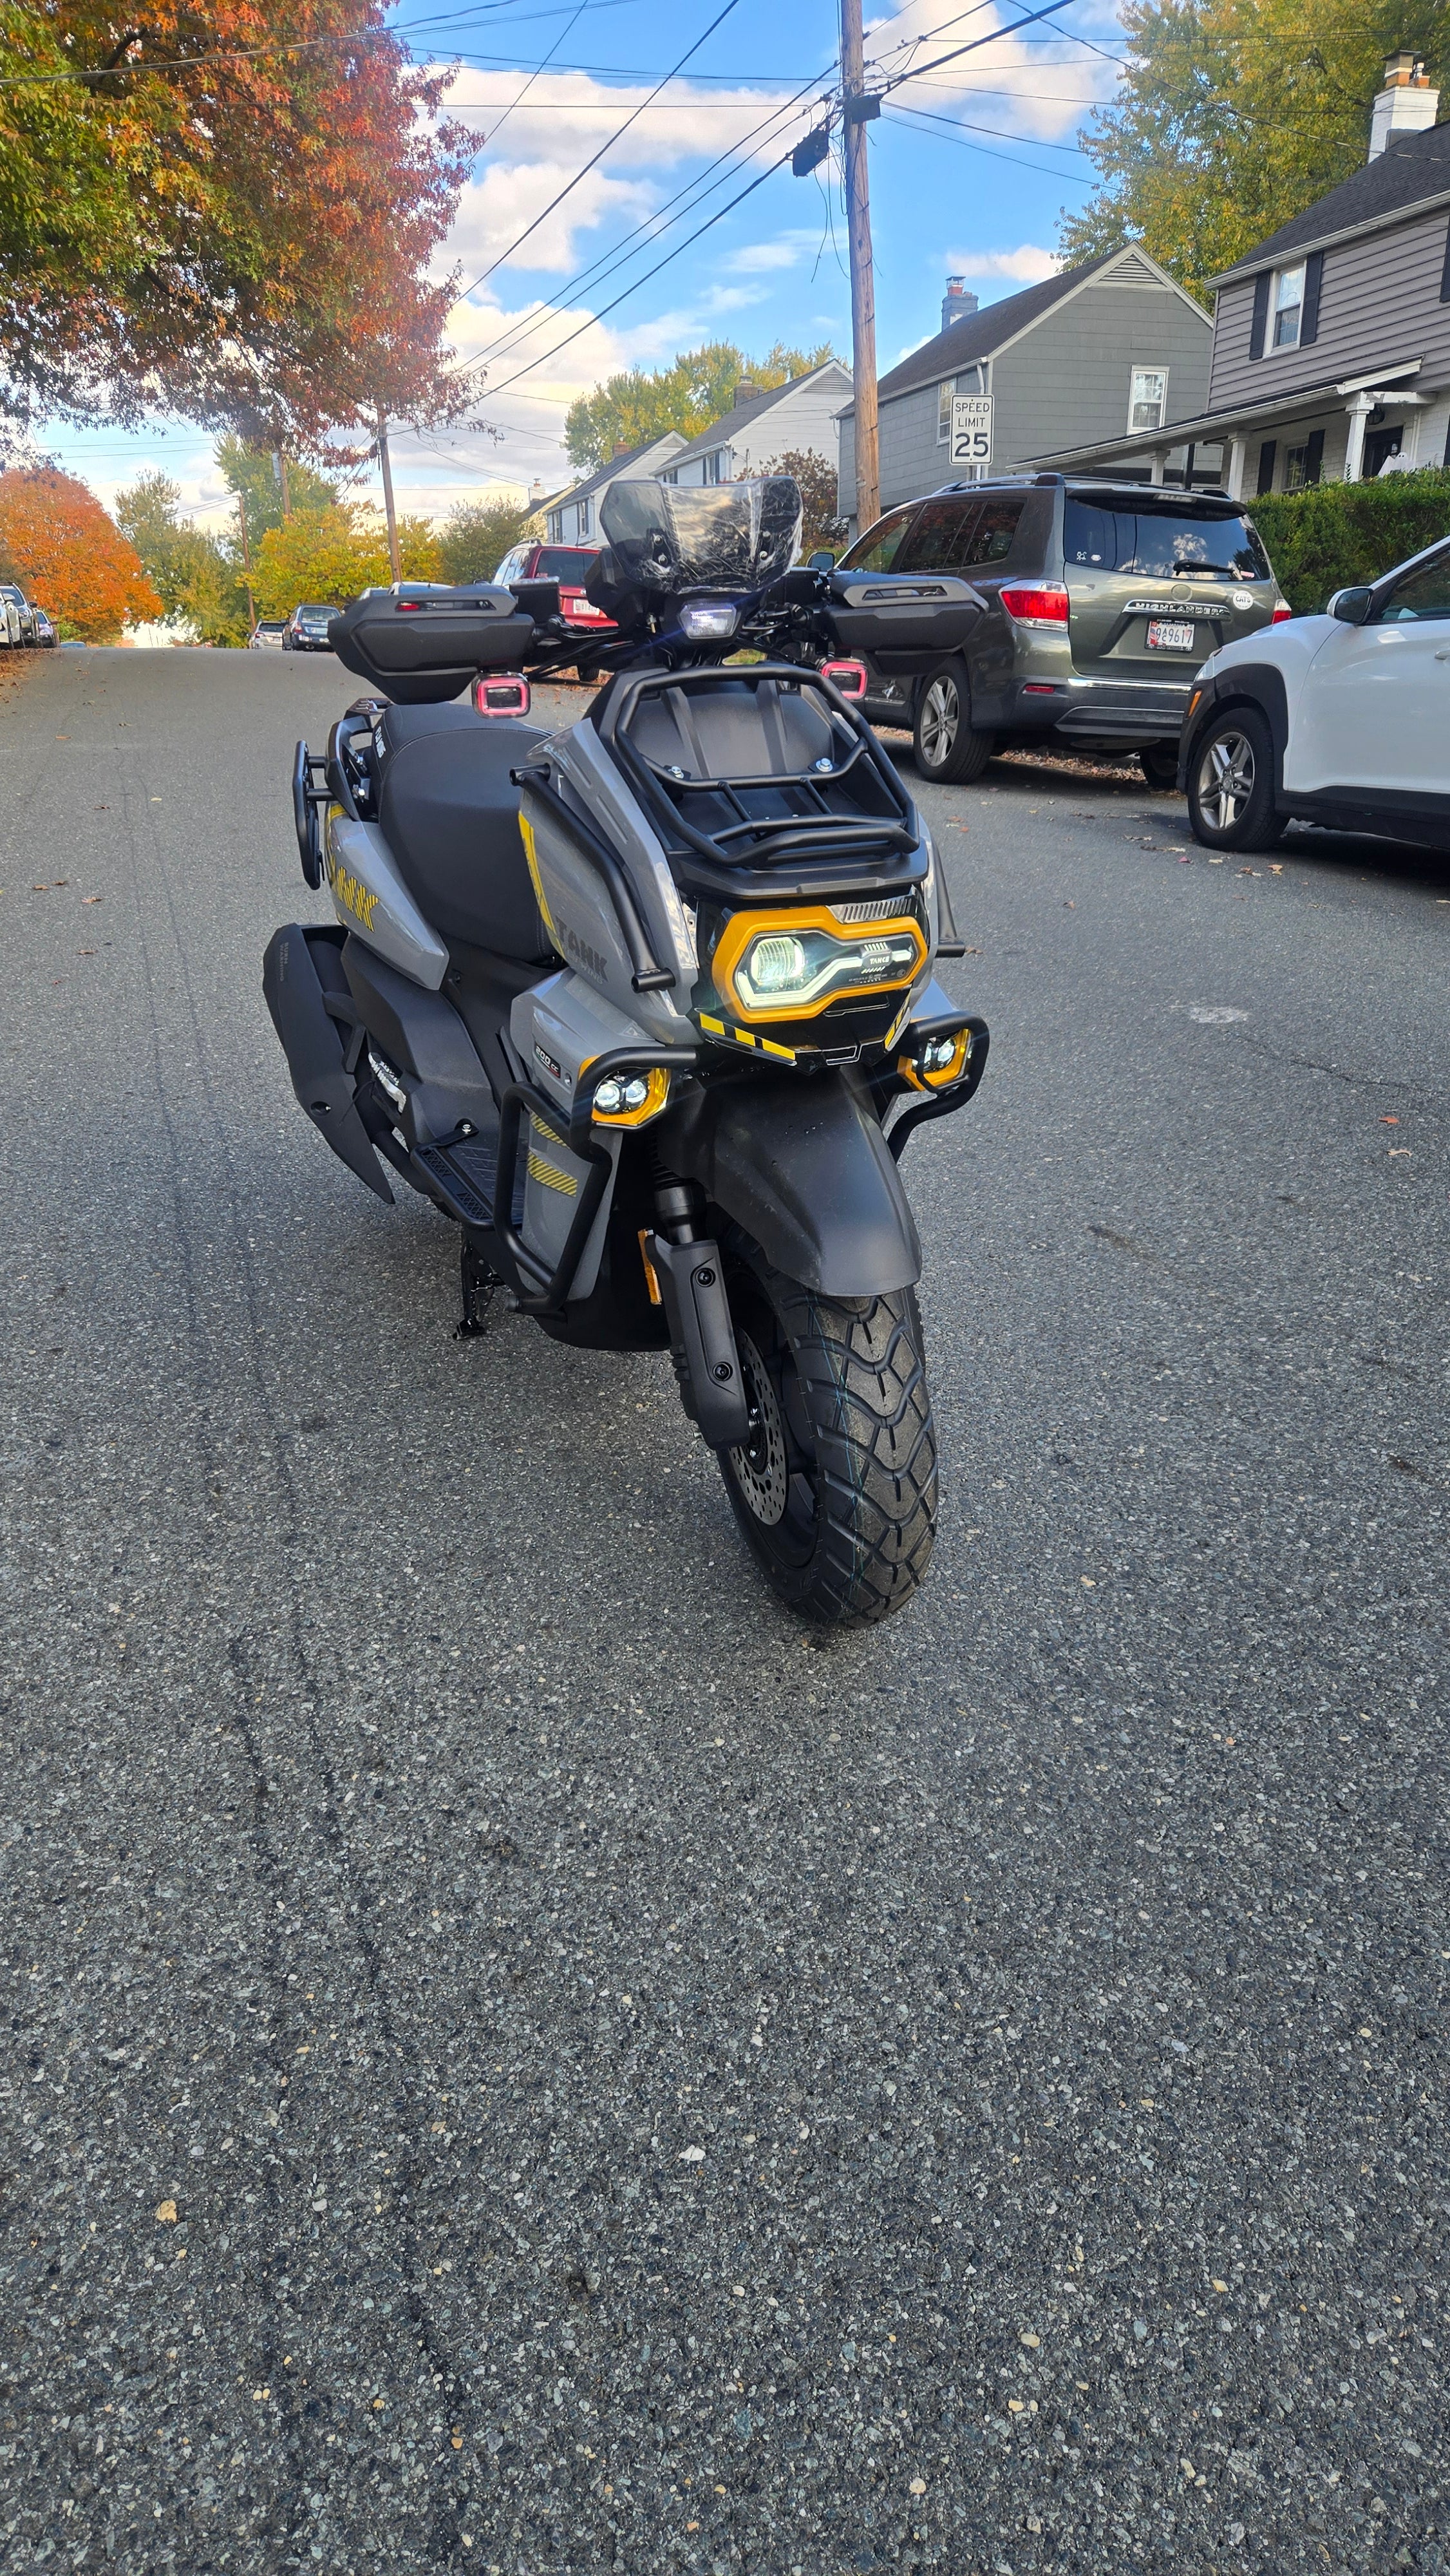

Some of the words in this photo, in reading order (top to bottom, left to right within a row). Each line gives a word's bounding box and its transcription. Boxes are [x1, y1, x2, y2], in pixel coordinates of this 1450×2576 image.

[955, 402, 990, 412] SPEED
[958, 417, 986, 427] LIMIT
[955, 432, 988, 457] 25
[1135, 602, 1221, 616] HIGHLANDER
[555, 915, 608, 982] TANK
[536, 1045, 551, 1065] 200
